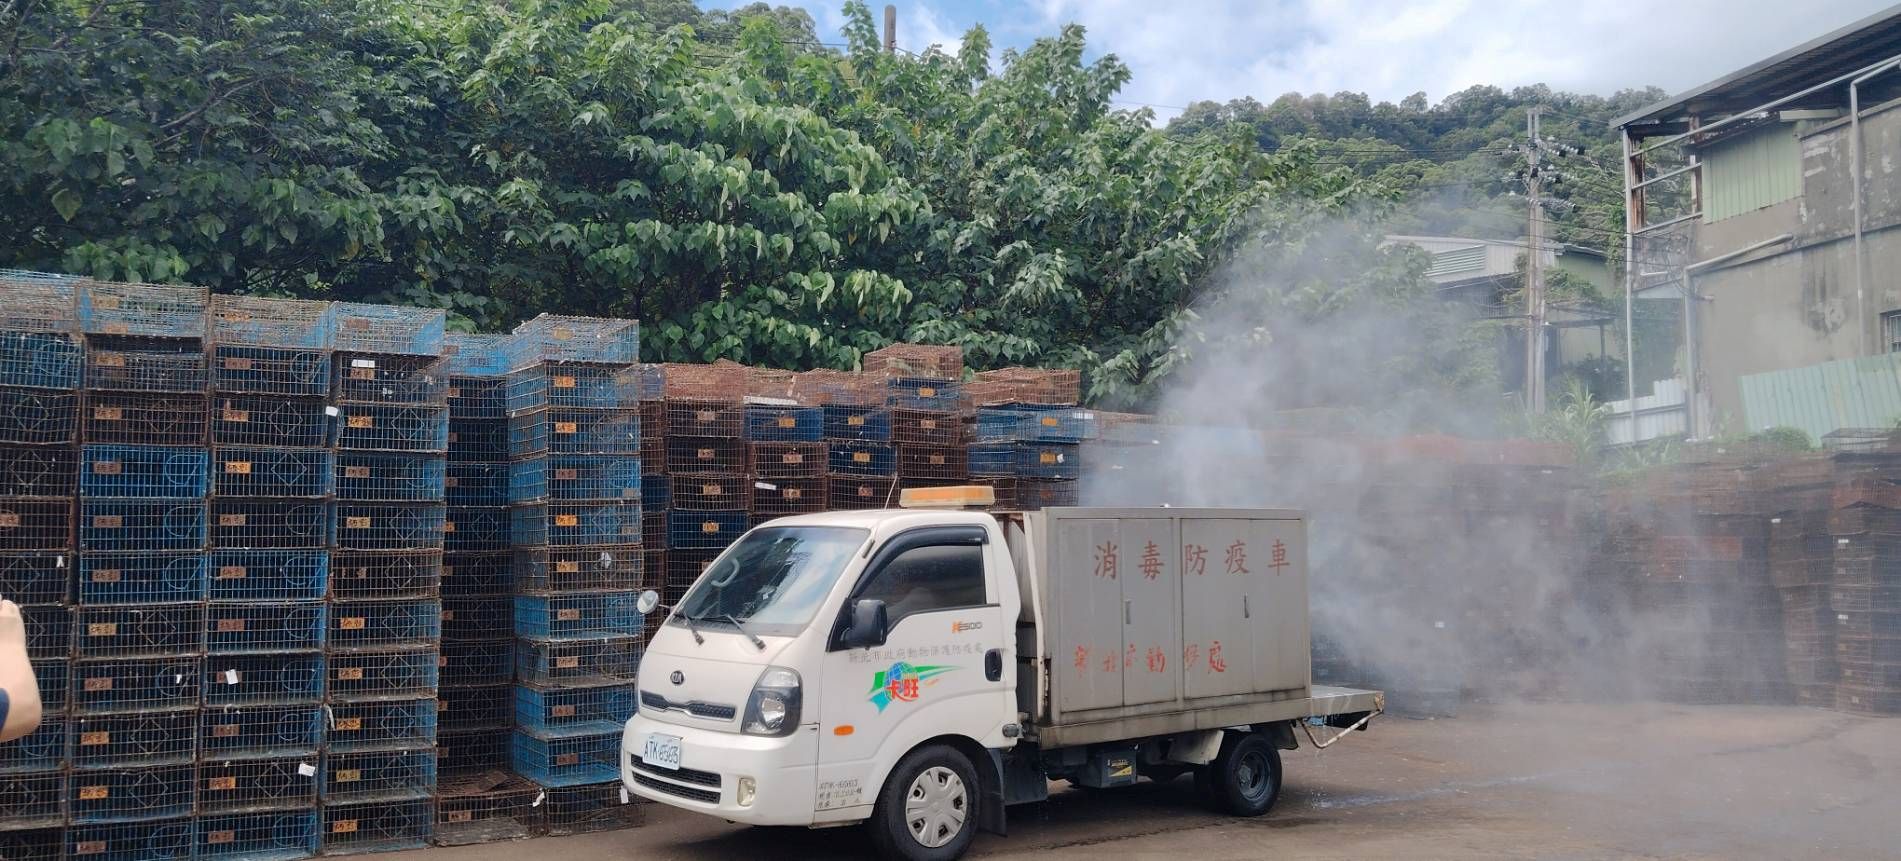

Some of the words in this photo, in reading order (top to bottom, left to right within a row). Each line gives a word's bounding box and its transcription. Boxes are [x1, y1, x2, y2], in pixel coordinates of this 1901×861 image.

[1093, 539, 1291, 581] 消毒防疫車
[885, 677, 919, 700] 卡旺
